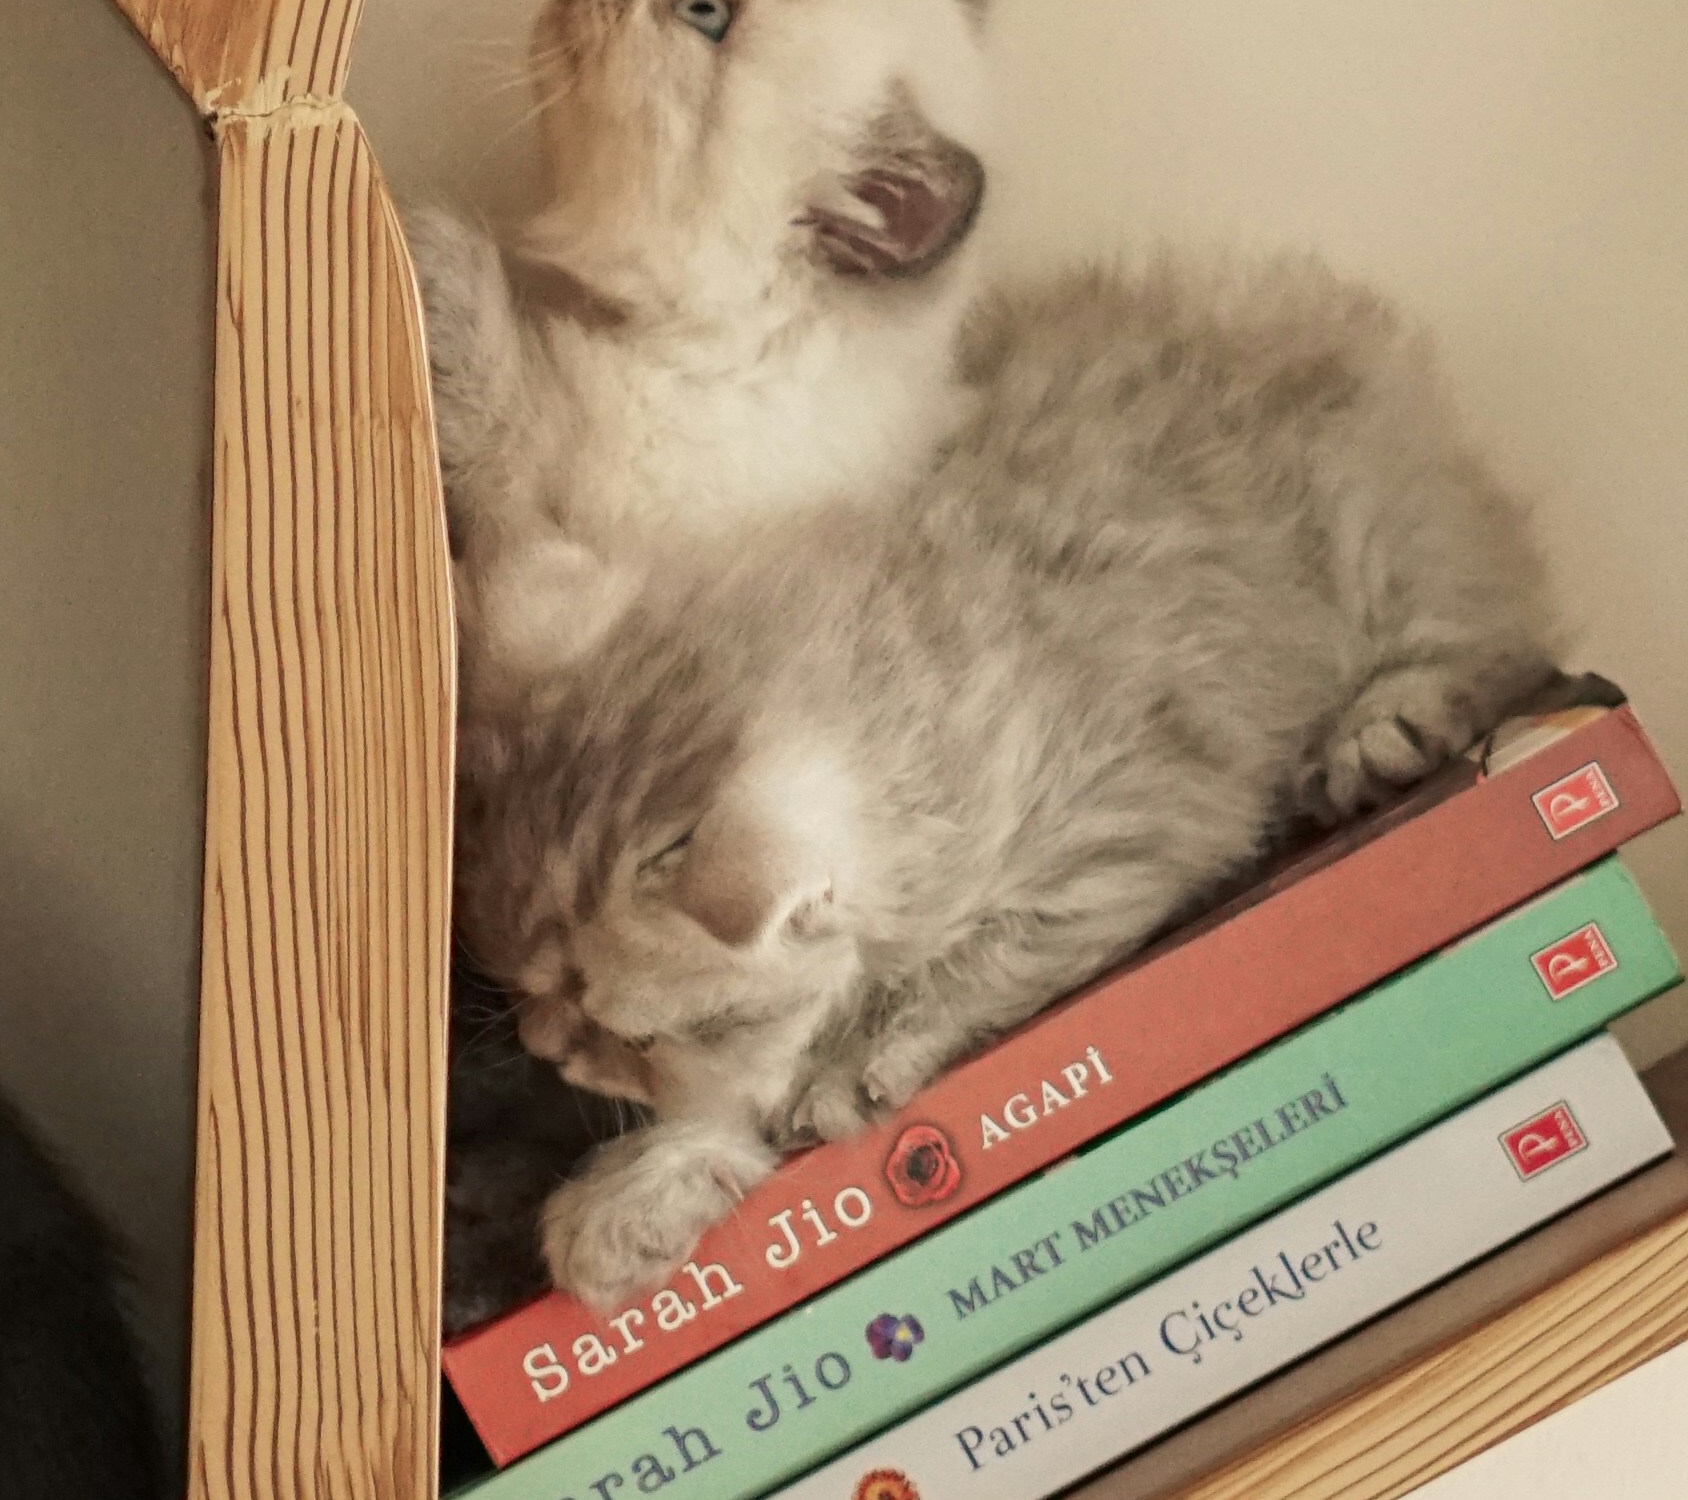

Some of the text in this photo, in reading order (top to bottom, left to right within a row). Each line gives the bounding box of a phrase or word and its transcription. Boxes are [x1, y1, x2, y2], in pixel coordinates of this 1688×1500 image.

[978, 1045, 1113, 1150] AGAPİ
[946, 1072, 1349, 1322] MART MENEKŞELERİ
[521, 1185, 871, 1402] Sarah Jio
[1159, 1217, 1384, 1364] Çiçeklerle
[744, 1350, 852, 1432] Jio
